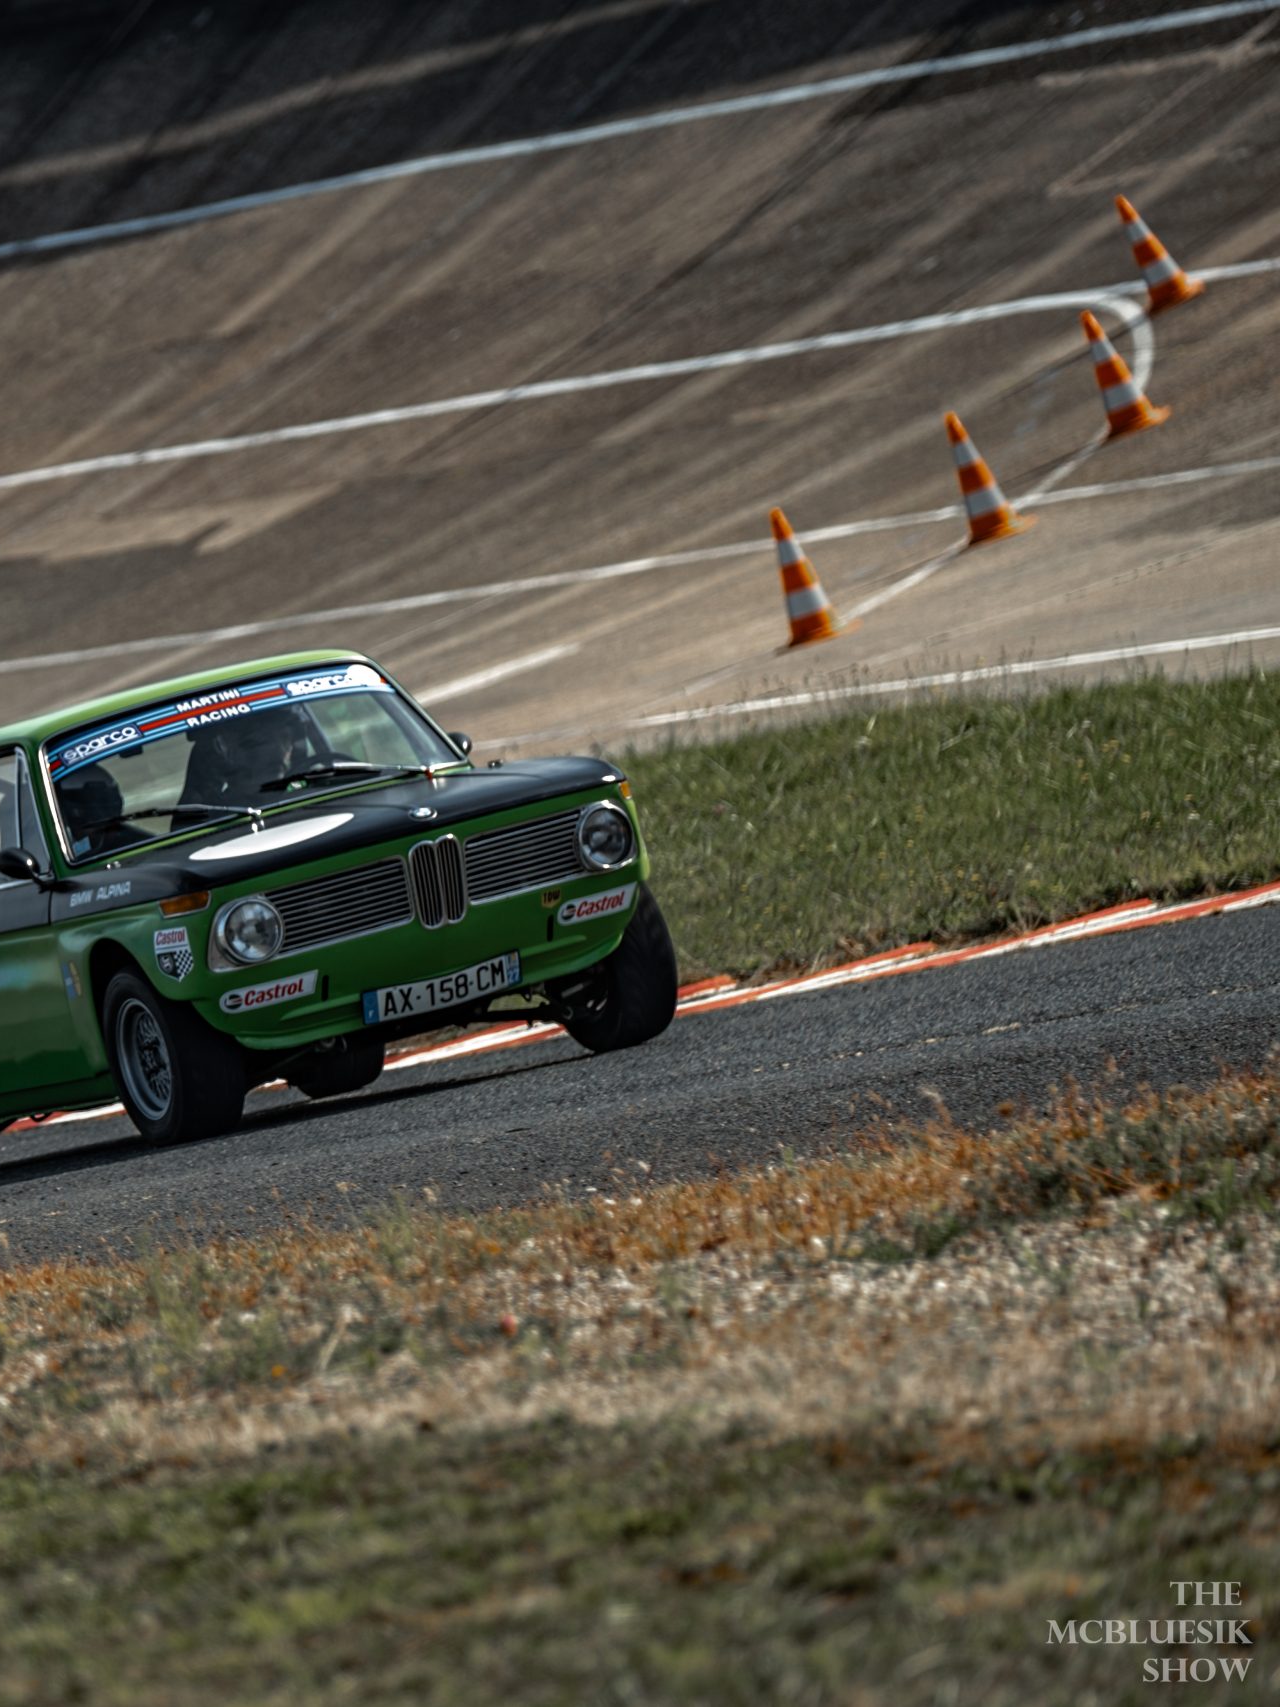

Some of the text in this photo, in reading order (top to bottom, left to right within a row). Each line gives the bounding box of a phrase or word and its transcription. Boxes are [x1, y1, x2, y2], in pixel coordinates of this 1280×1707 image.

[176, 688, 240, 712] MARTINI
[186, 704, 251, 727] RACING
[63, 726, 137, 761] sparco
[69, 880, 131, 907] BMW ALPINA
[576, 890, 625, 918] Castrol
[156, 929, 186, 946] Castrol
[244, 978, 304, 1007] Castrol
